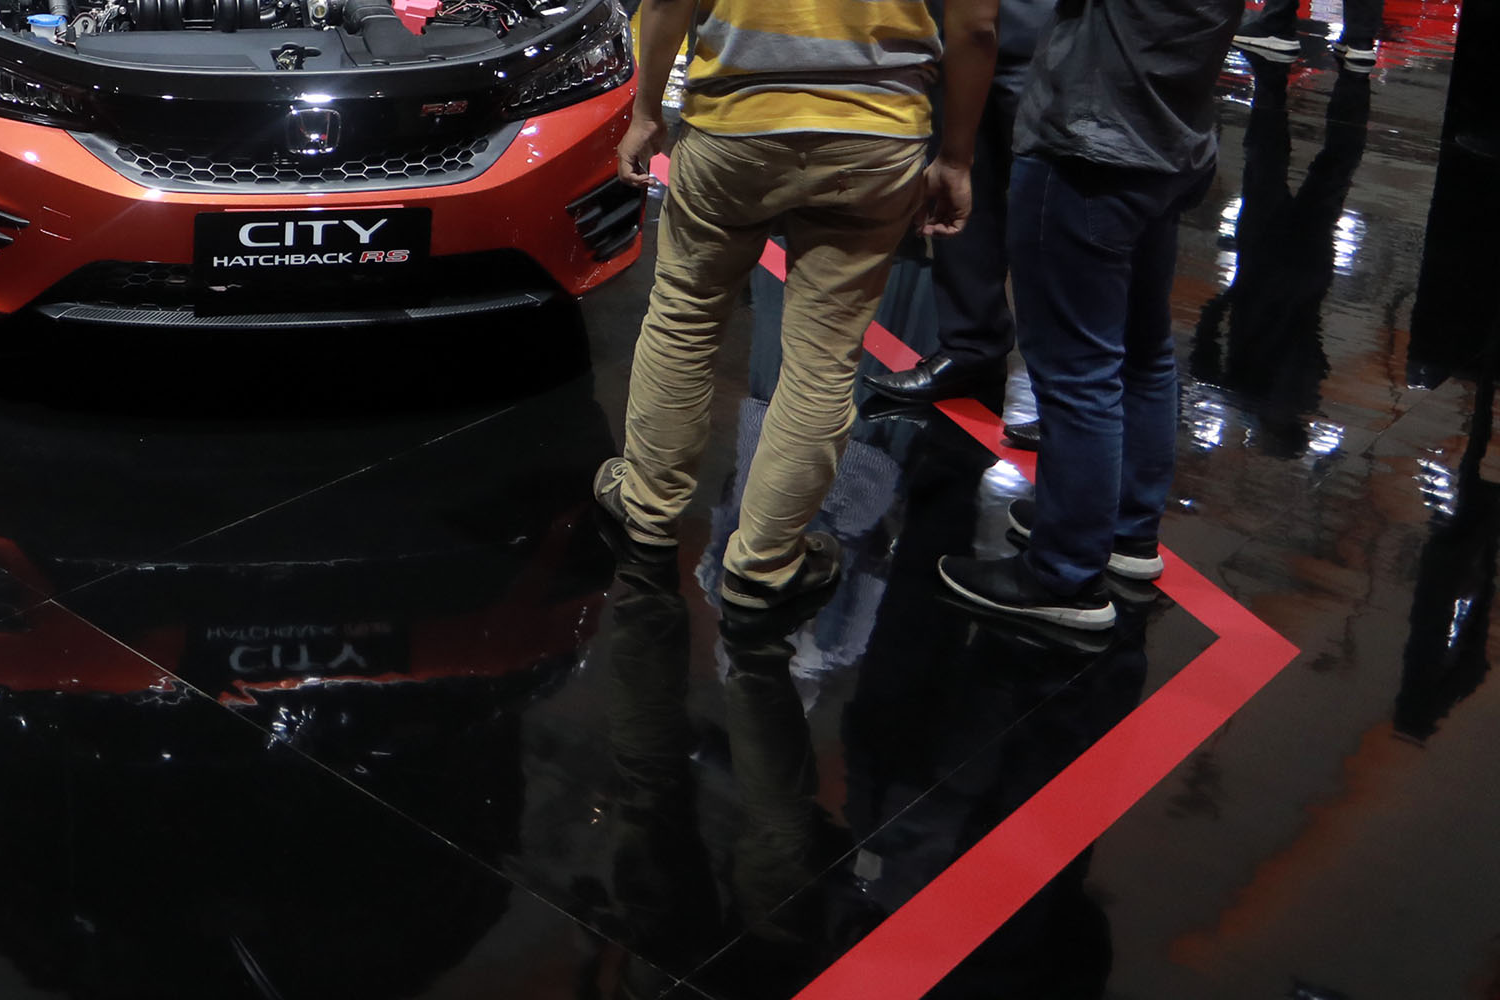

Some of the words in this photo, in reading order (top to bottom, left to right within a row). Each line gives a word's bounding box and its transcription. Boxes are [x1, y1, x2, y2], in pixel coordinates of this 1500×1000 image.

[238, 218, 388, 247] CITY
[213, 252, 353, 268] HATCHBACK
[358, 249, 410, 263] RS
